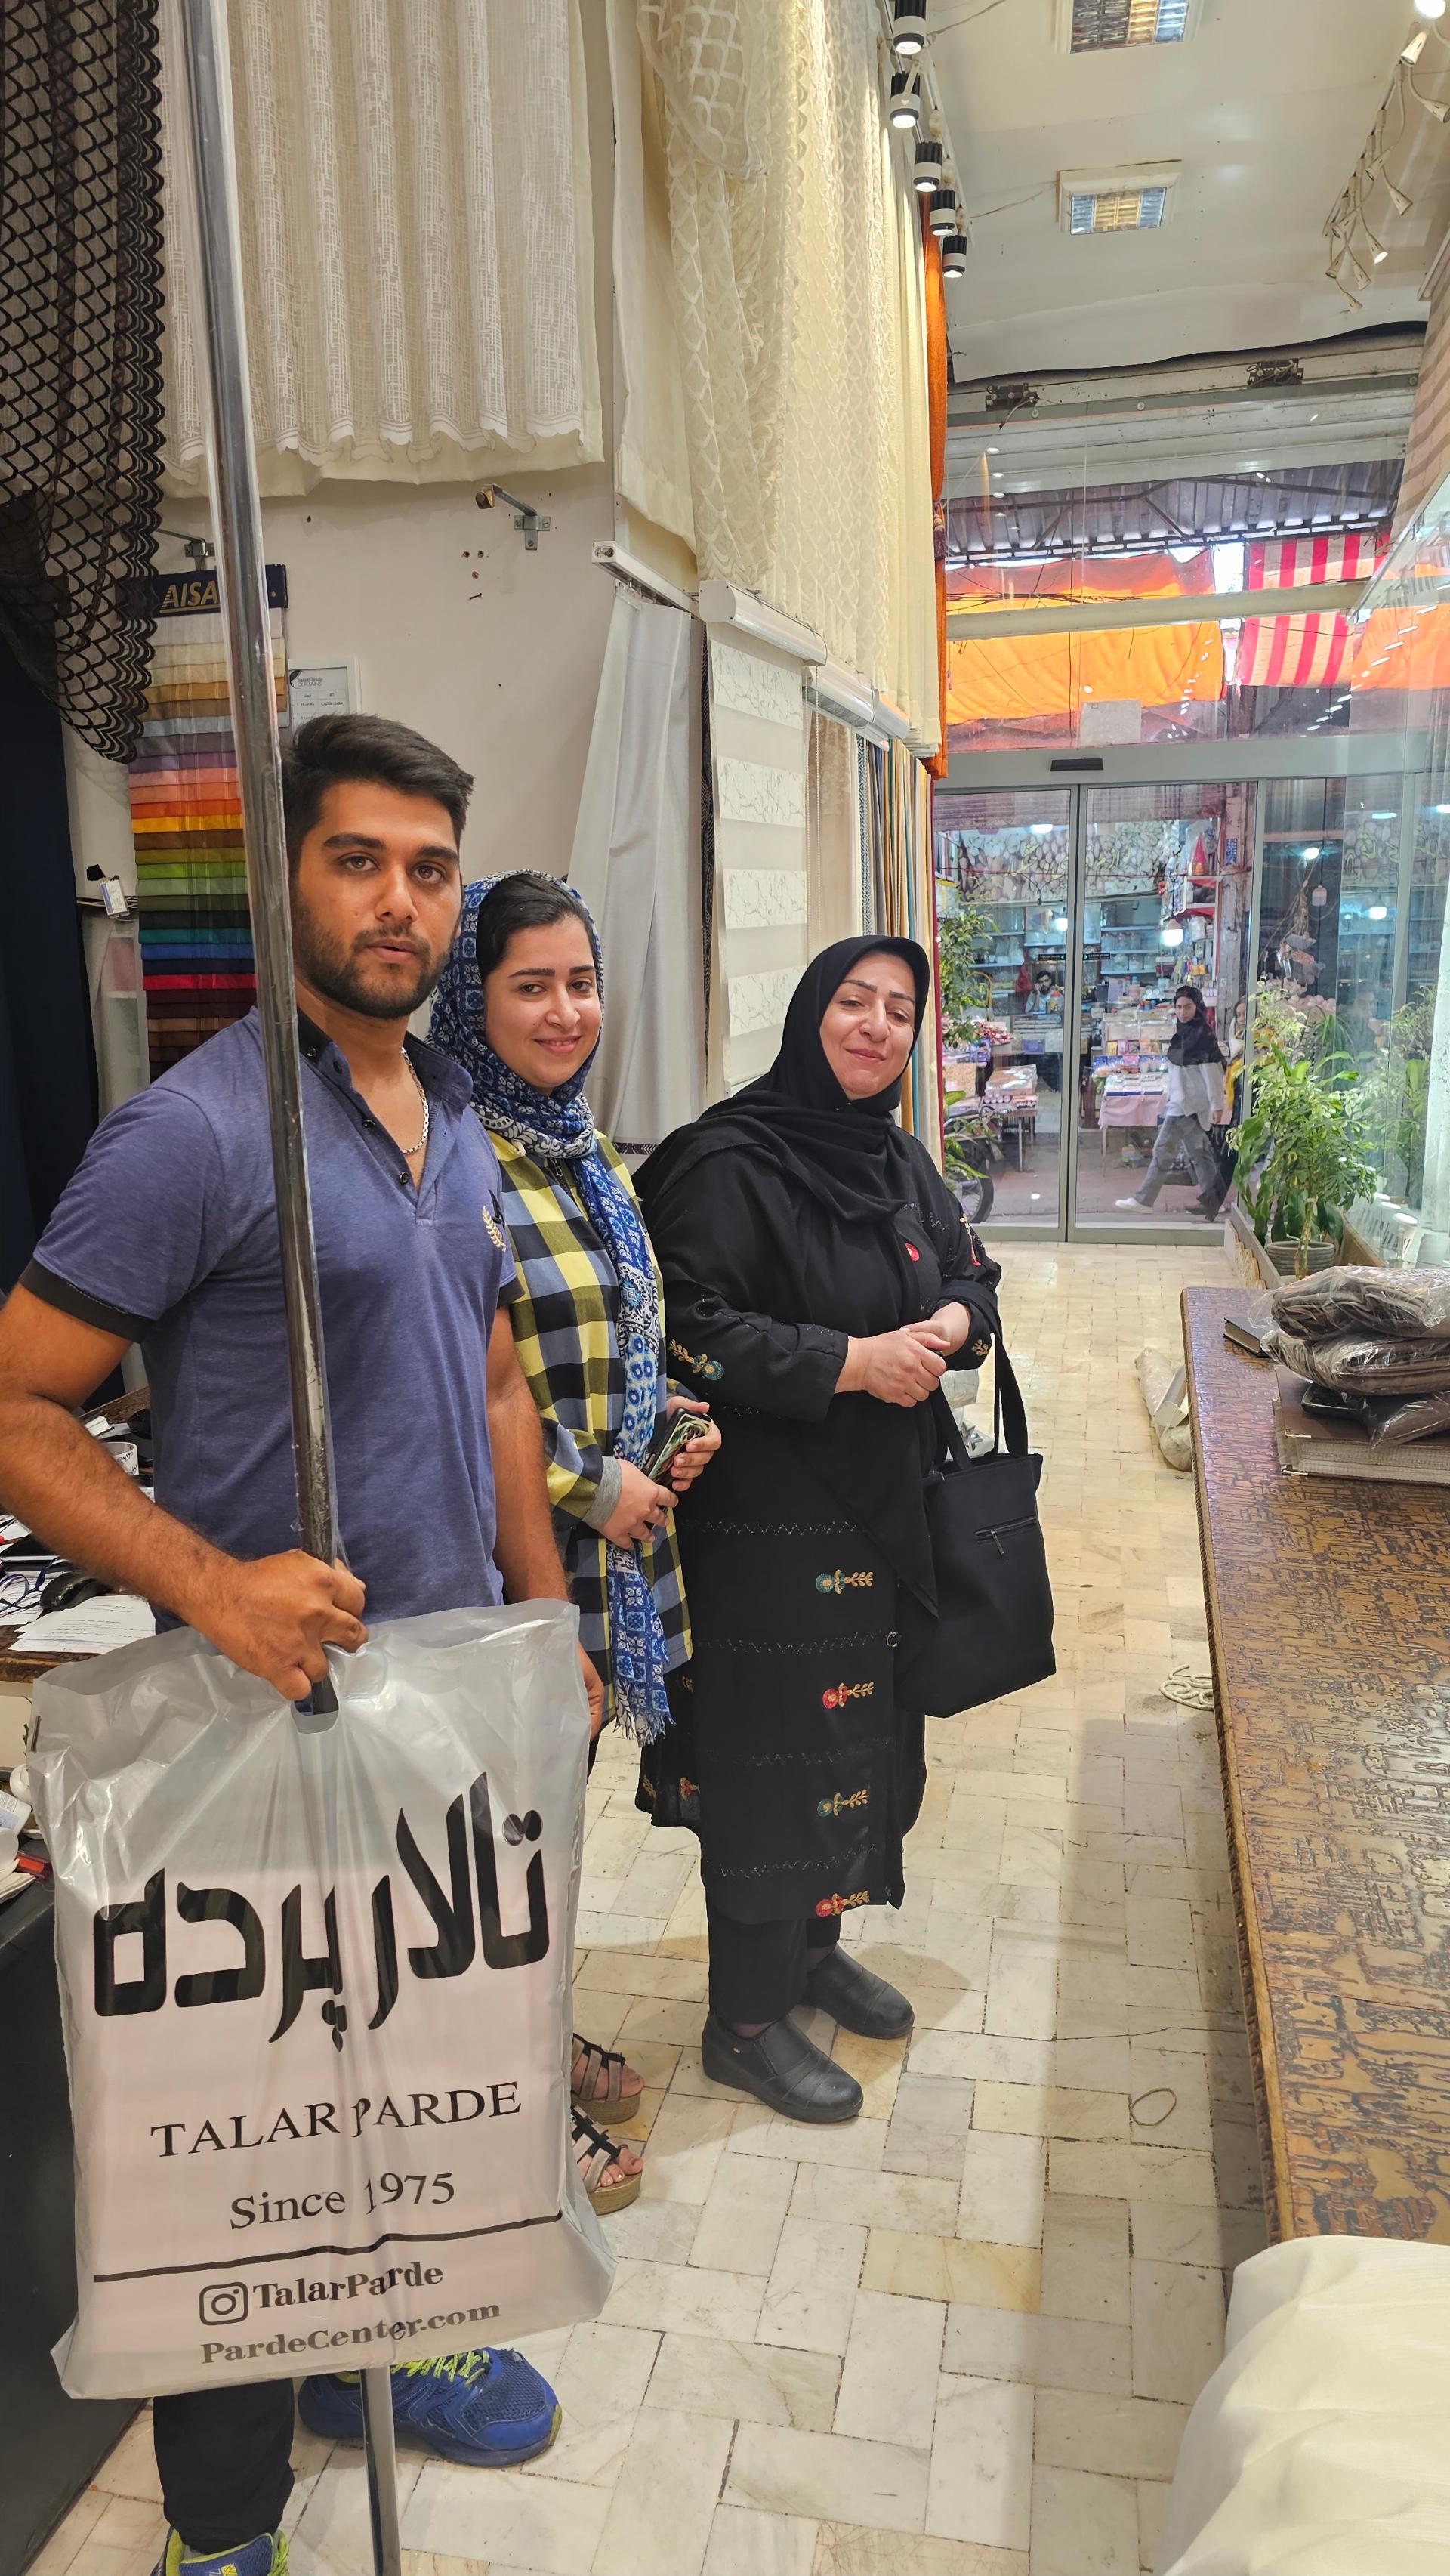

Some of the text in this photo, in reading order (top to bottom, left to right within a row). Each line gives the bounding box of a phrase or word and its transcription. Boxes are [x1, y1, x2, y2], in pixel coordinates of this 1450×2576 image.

[94, 1771, 551, 2053] تالار پرده
[151, 2081, 522, 2157] TALAR PARDE
[230, 2172, 455, 2230] Since 1975
[253, 2262, 444, 2309] TalarParde
[201, 2303, 502, 2364] PardeCenter.com
